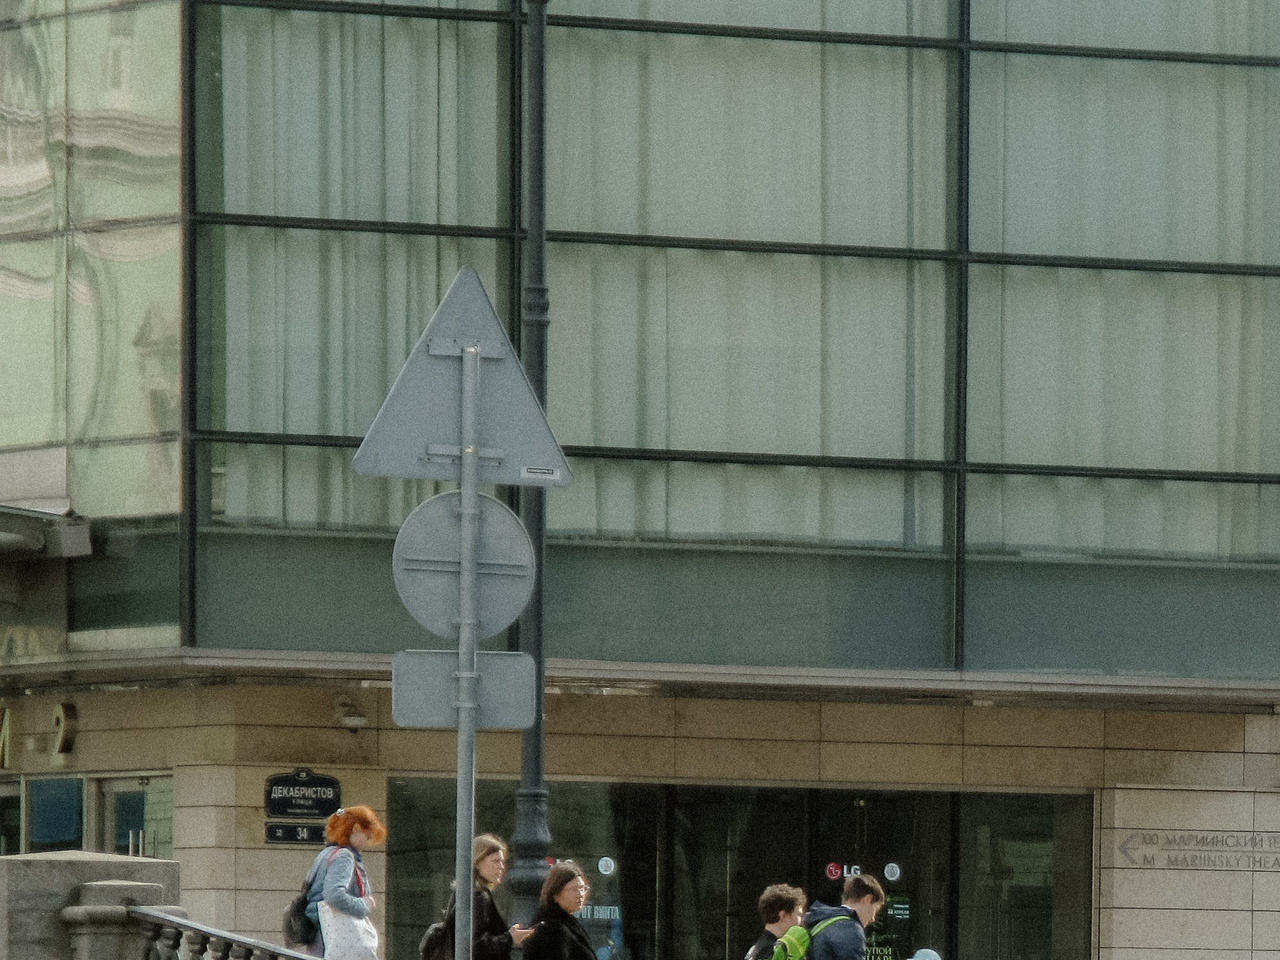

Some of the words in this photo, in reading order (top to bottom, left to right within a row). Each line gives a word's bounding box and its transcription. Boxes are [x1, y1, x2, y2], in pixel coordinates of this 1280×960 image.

[271, 786, 334, 799] ДЕКАБРИСТОВ
[296, 827, 308, 840] 34
[1164, 832, 1264, 848] МАРИИНСКИЙ
[1166, 854, 1243, 868] MARIINSKY
[843, 865, 861, 877] LG
[865, 945, 892, 955] УПОЙ
